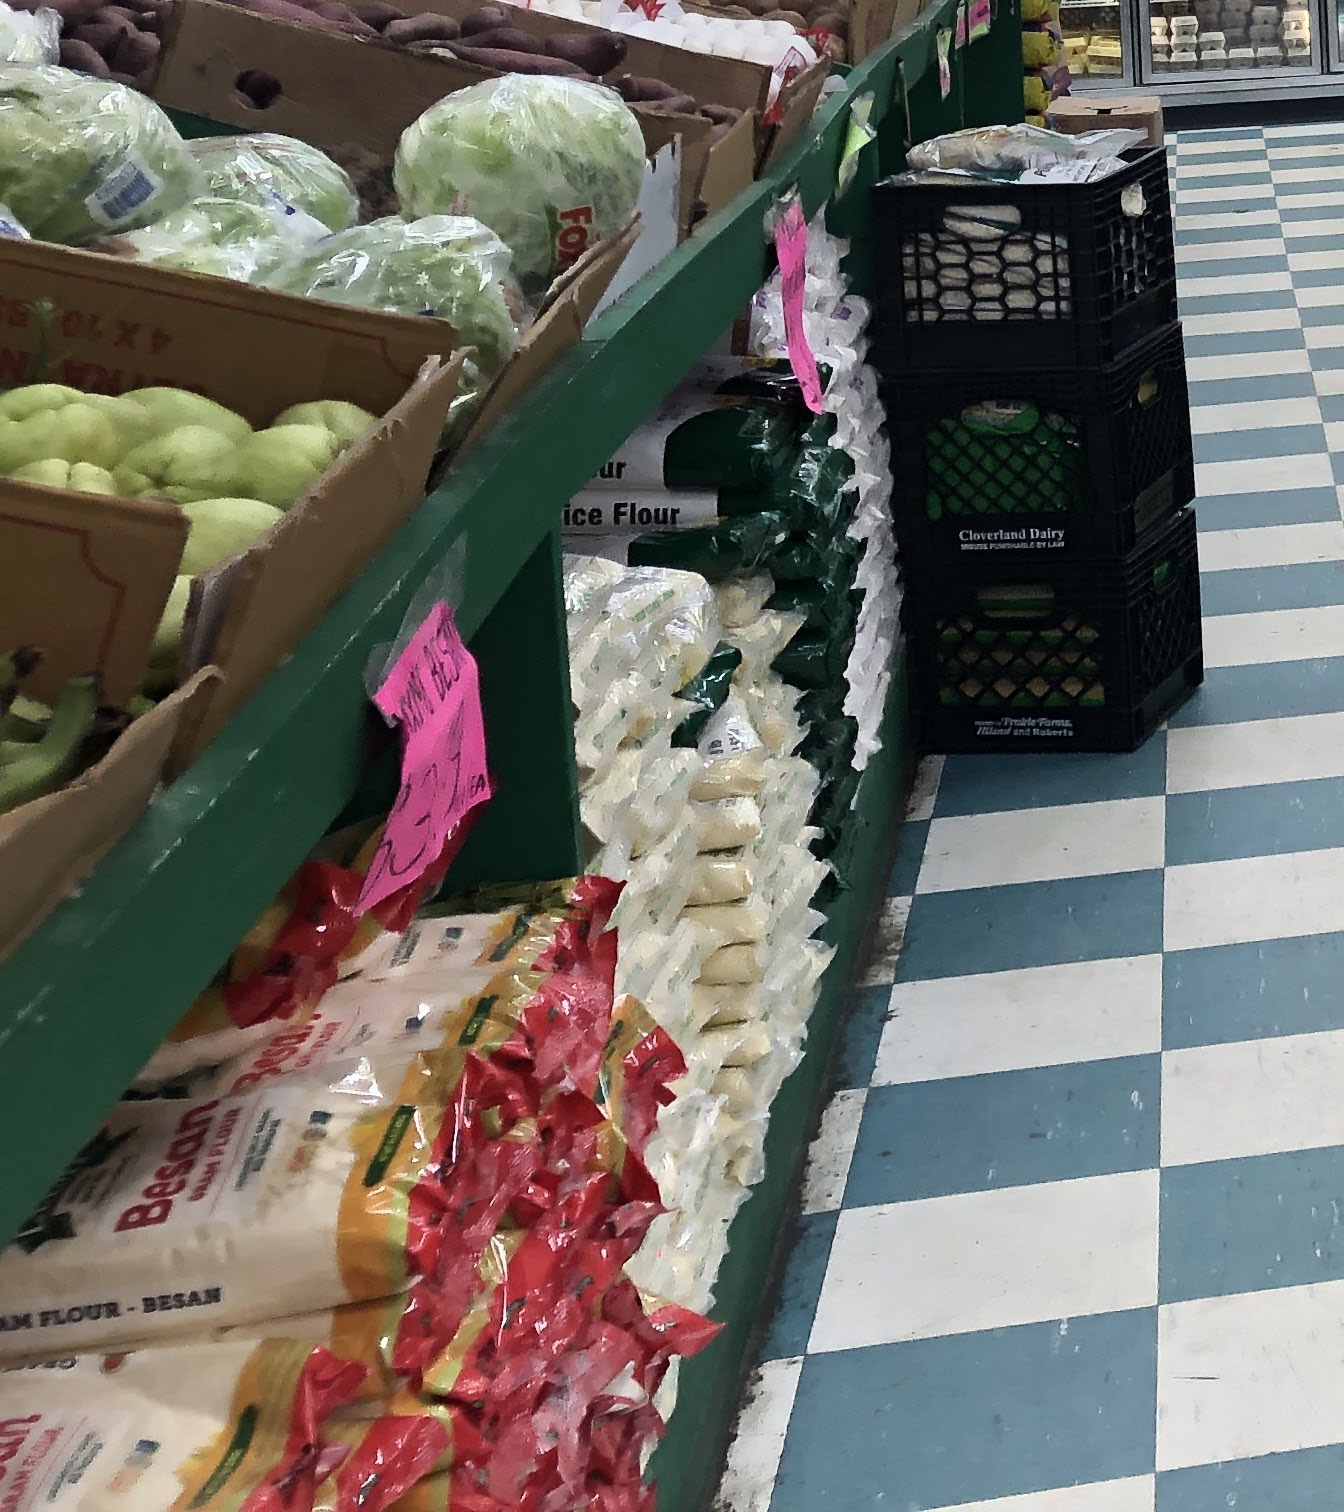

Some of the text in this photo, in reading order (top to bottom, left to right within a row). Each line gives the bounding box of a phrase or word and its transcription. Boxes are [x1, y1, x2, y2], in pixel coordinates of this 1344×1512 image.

[563, 502, 681, 526] ice Flour
[958, 527, 1065, 541] Cloverland Dairy
[1013, 728, 1031, 736] and
[207, 1108, 242, 1159] FLOUR
[113, 1099, 220, 1233] Besan
[39, 1301, 121, 1328] FLOUR
[141, 1286, 223, 1313] BESAN
